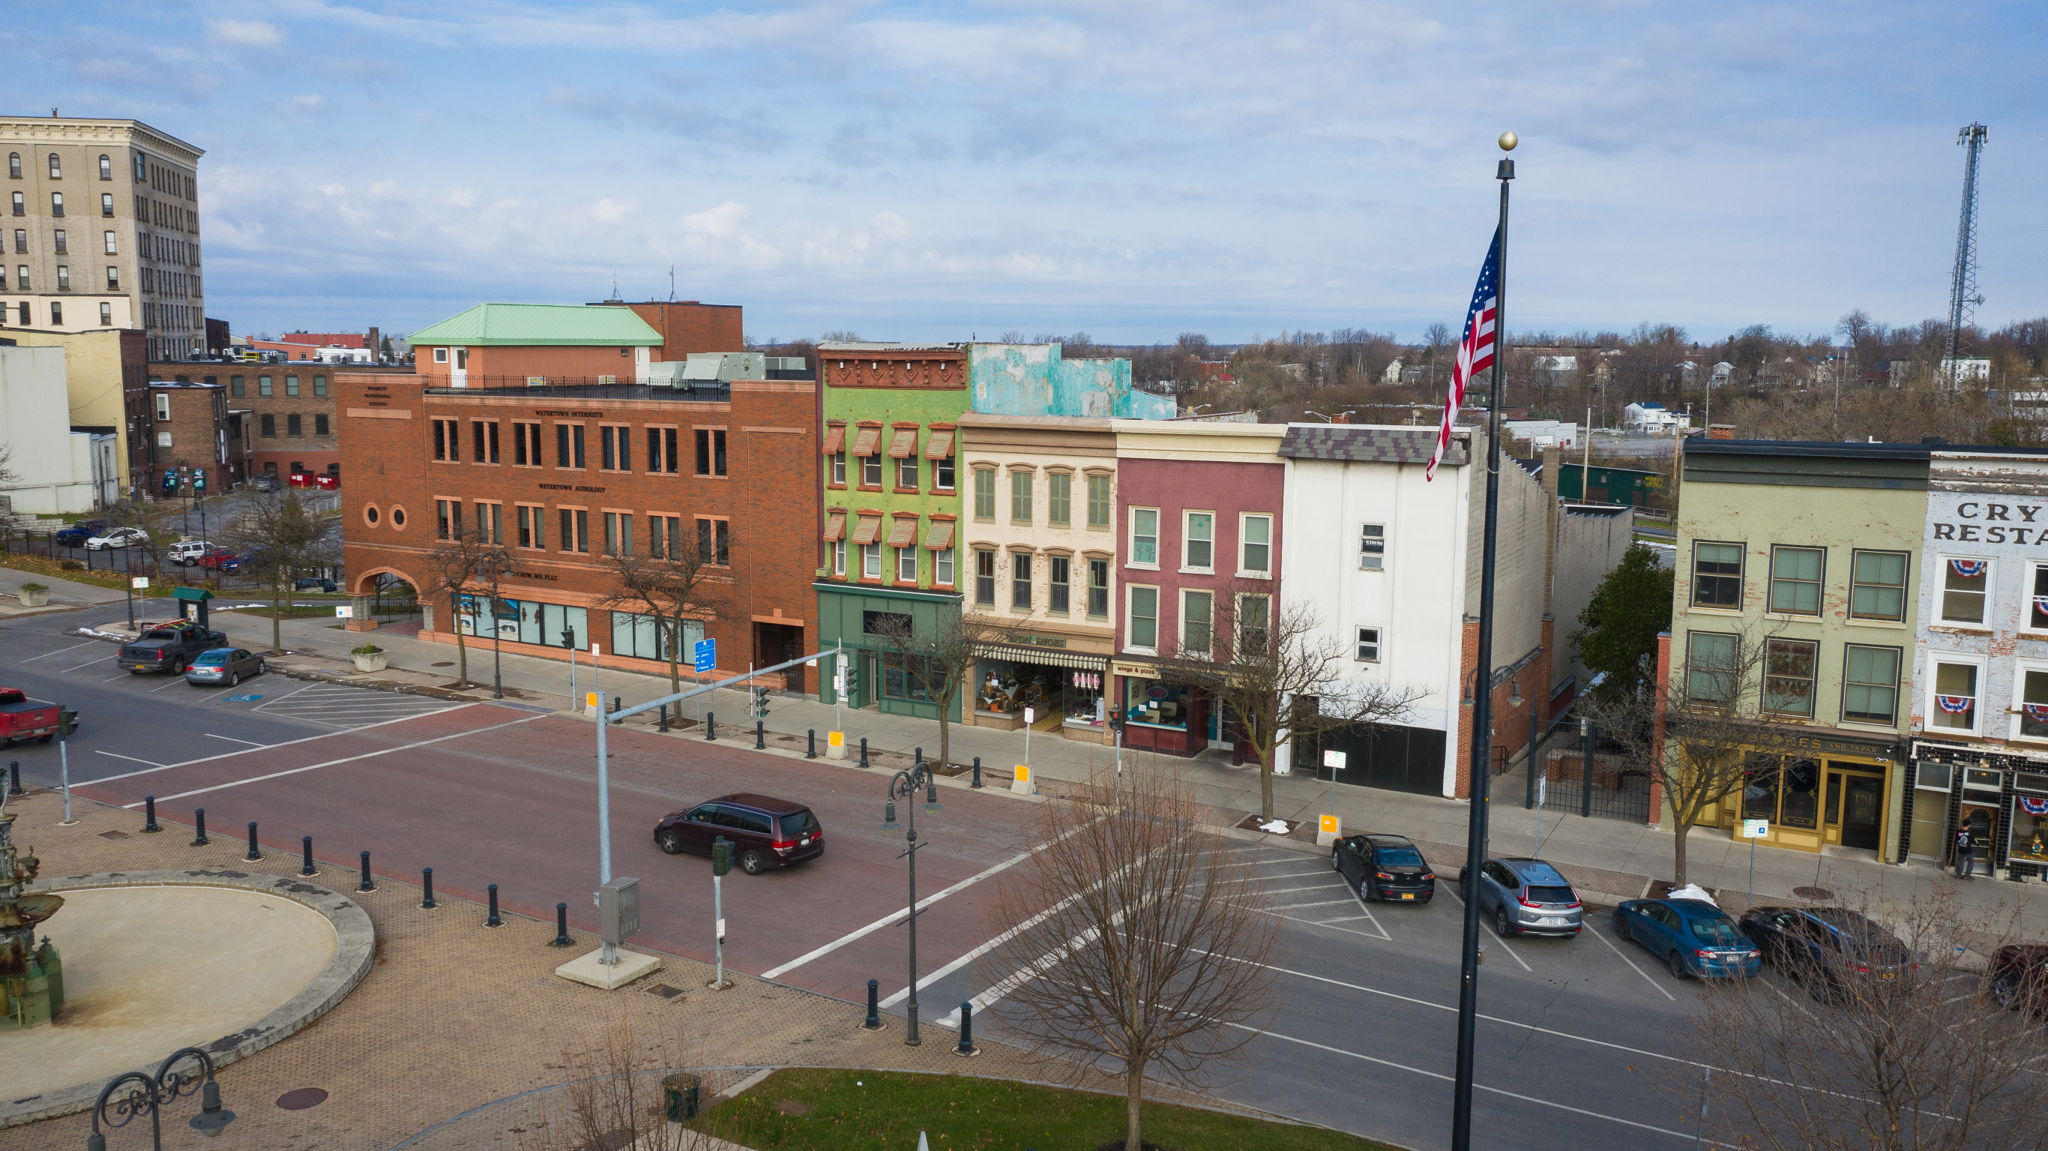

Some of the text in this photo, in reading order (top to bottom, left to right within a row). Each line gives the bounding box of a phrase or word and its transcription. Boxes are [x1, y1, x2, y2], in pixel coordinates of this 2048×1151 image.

[538, 483, 606, 493] WATERTOWN AUDIOLOGY
[1074, 672, 1099, 690] SALE
